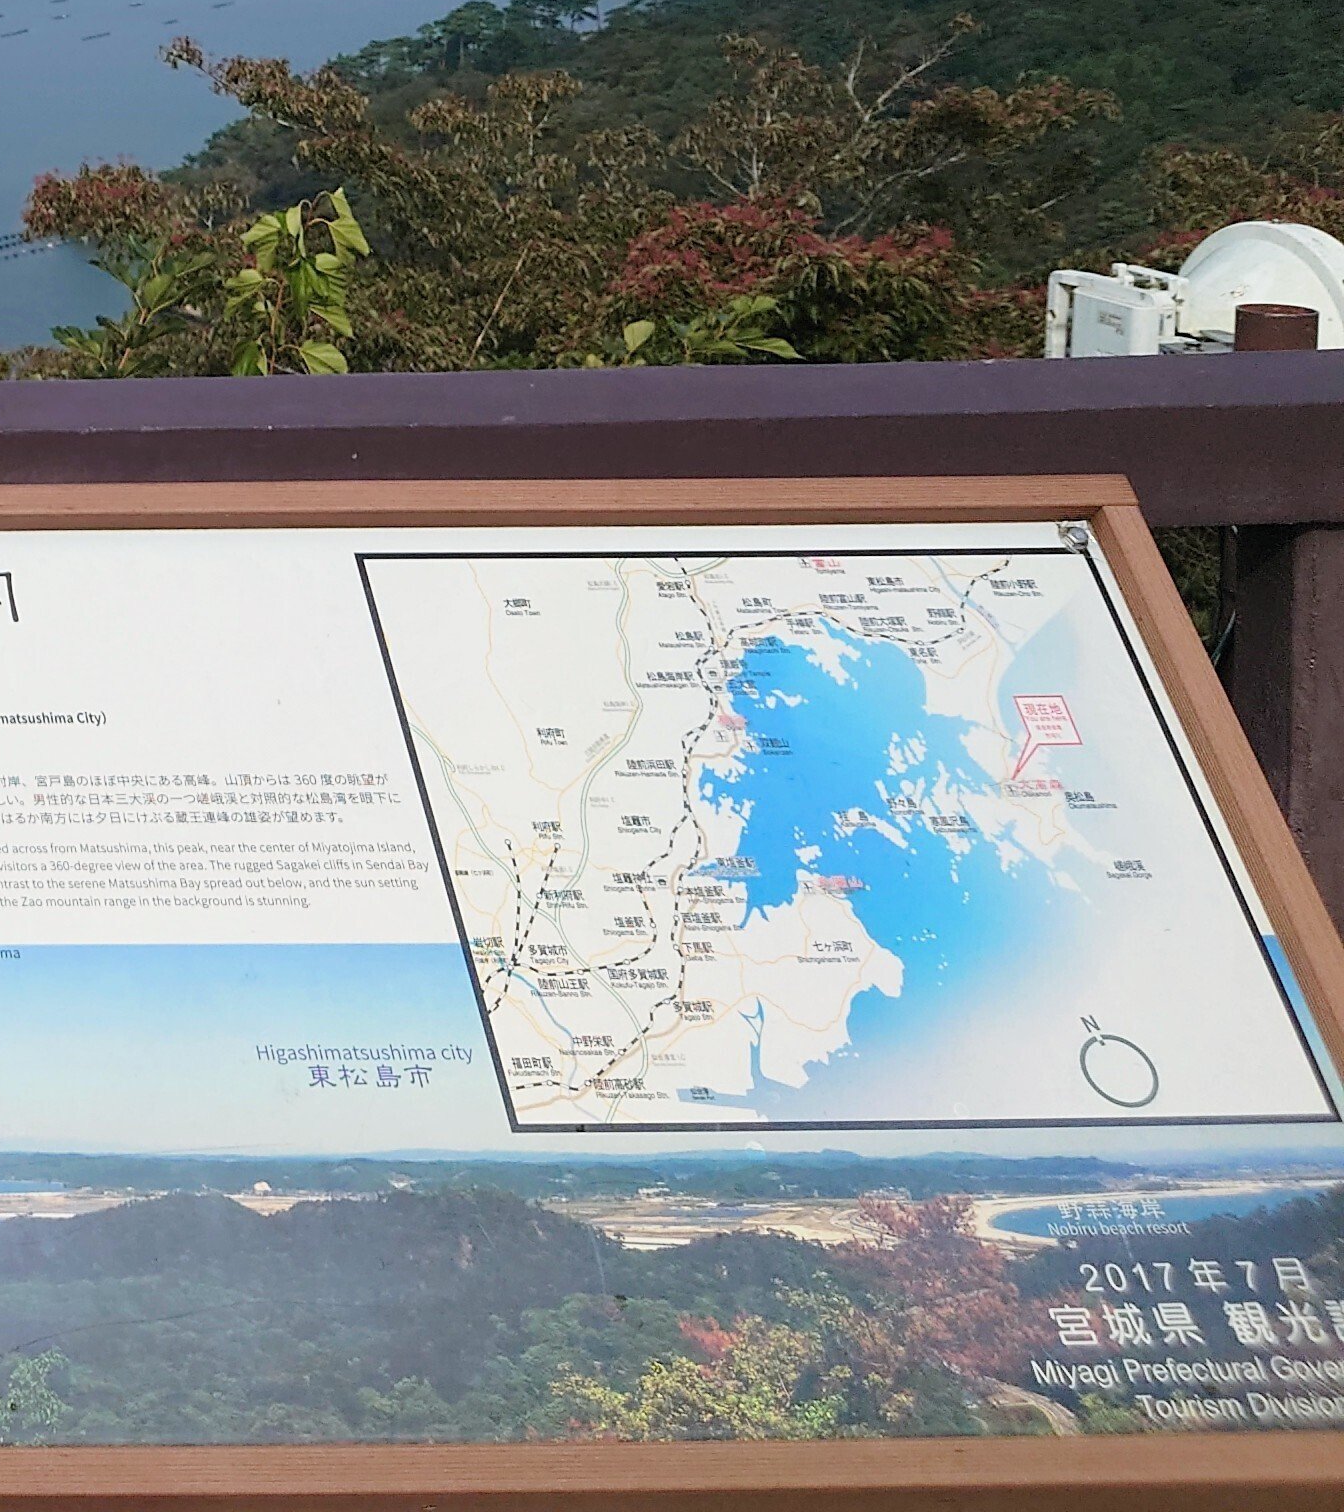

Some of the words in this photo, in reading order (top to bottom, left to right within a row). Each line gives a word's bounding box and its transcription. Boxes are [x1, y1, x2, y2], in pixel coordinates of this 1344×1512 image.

[1080, 1015, 1100, 1033] N
[254, 1042, 437, 1067] Higashimatsushima
[440, 1043, 472, 1065] city
[1047, 1222, 1098, 1236] Nobiru
[1098, 1221, 1146, 1236] beach
[1146, 1221, 1191, 1235] resort
[1030, 1358, 1121, 1389] Miyagi
[1122, 1355, 1269, 1384] Prefectural
[1135, 1394, 1248, 1422] Tourism
